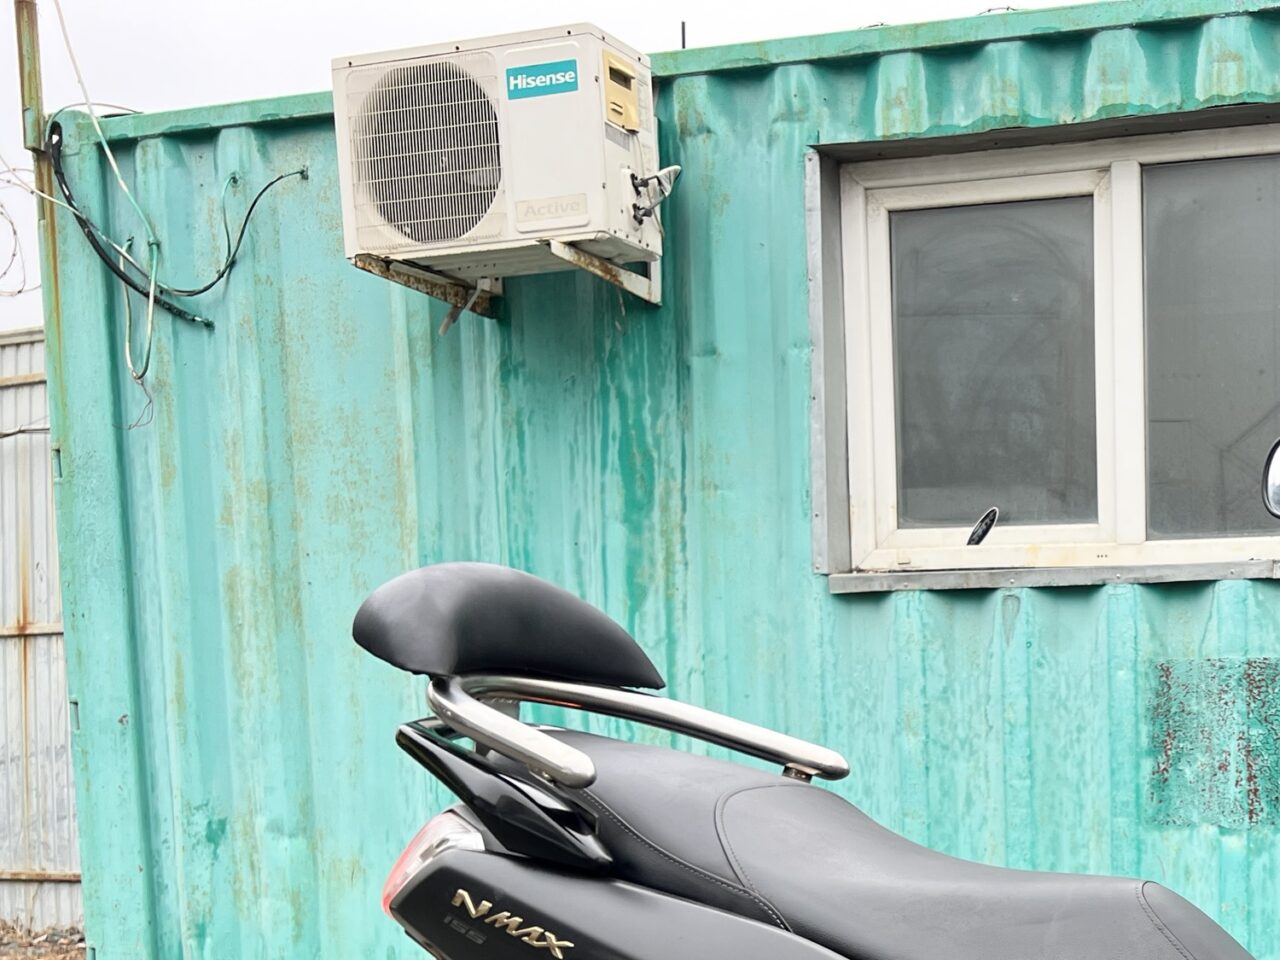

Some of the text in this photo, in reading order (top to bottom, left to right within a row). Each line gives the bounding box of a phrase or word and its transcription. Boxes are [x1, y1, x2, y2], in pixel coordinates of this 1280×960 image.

[509, 71, 576, 90] Hisense
[524, 201, 580, 217] Active
[451, 889, 575, 959] NMAX
